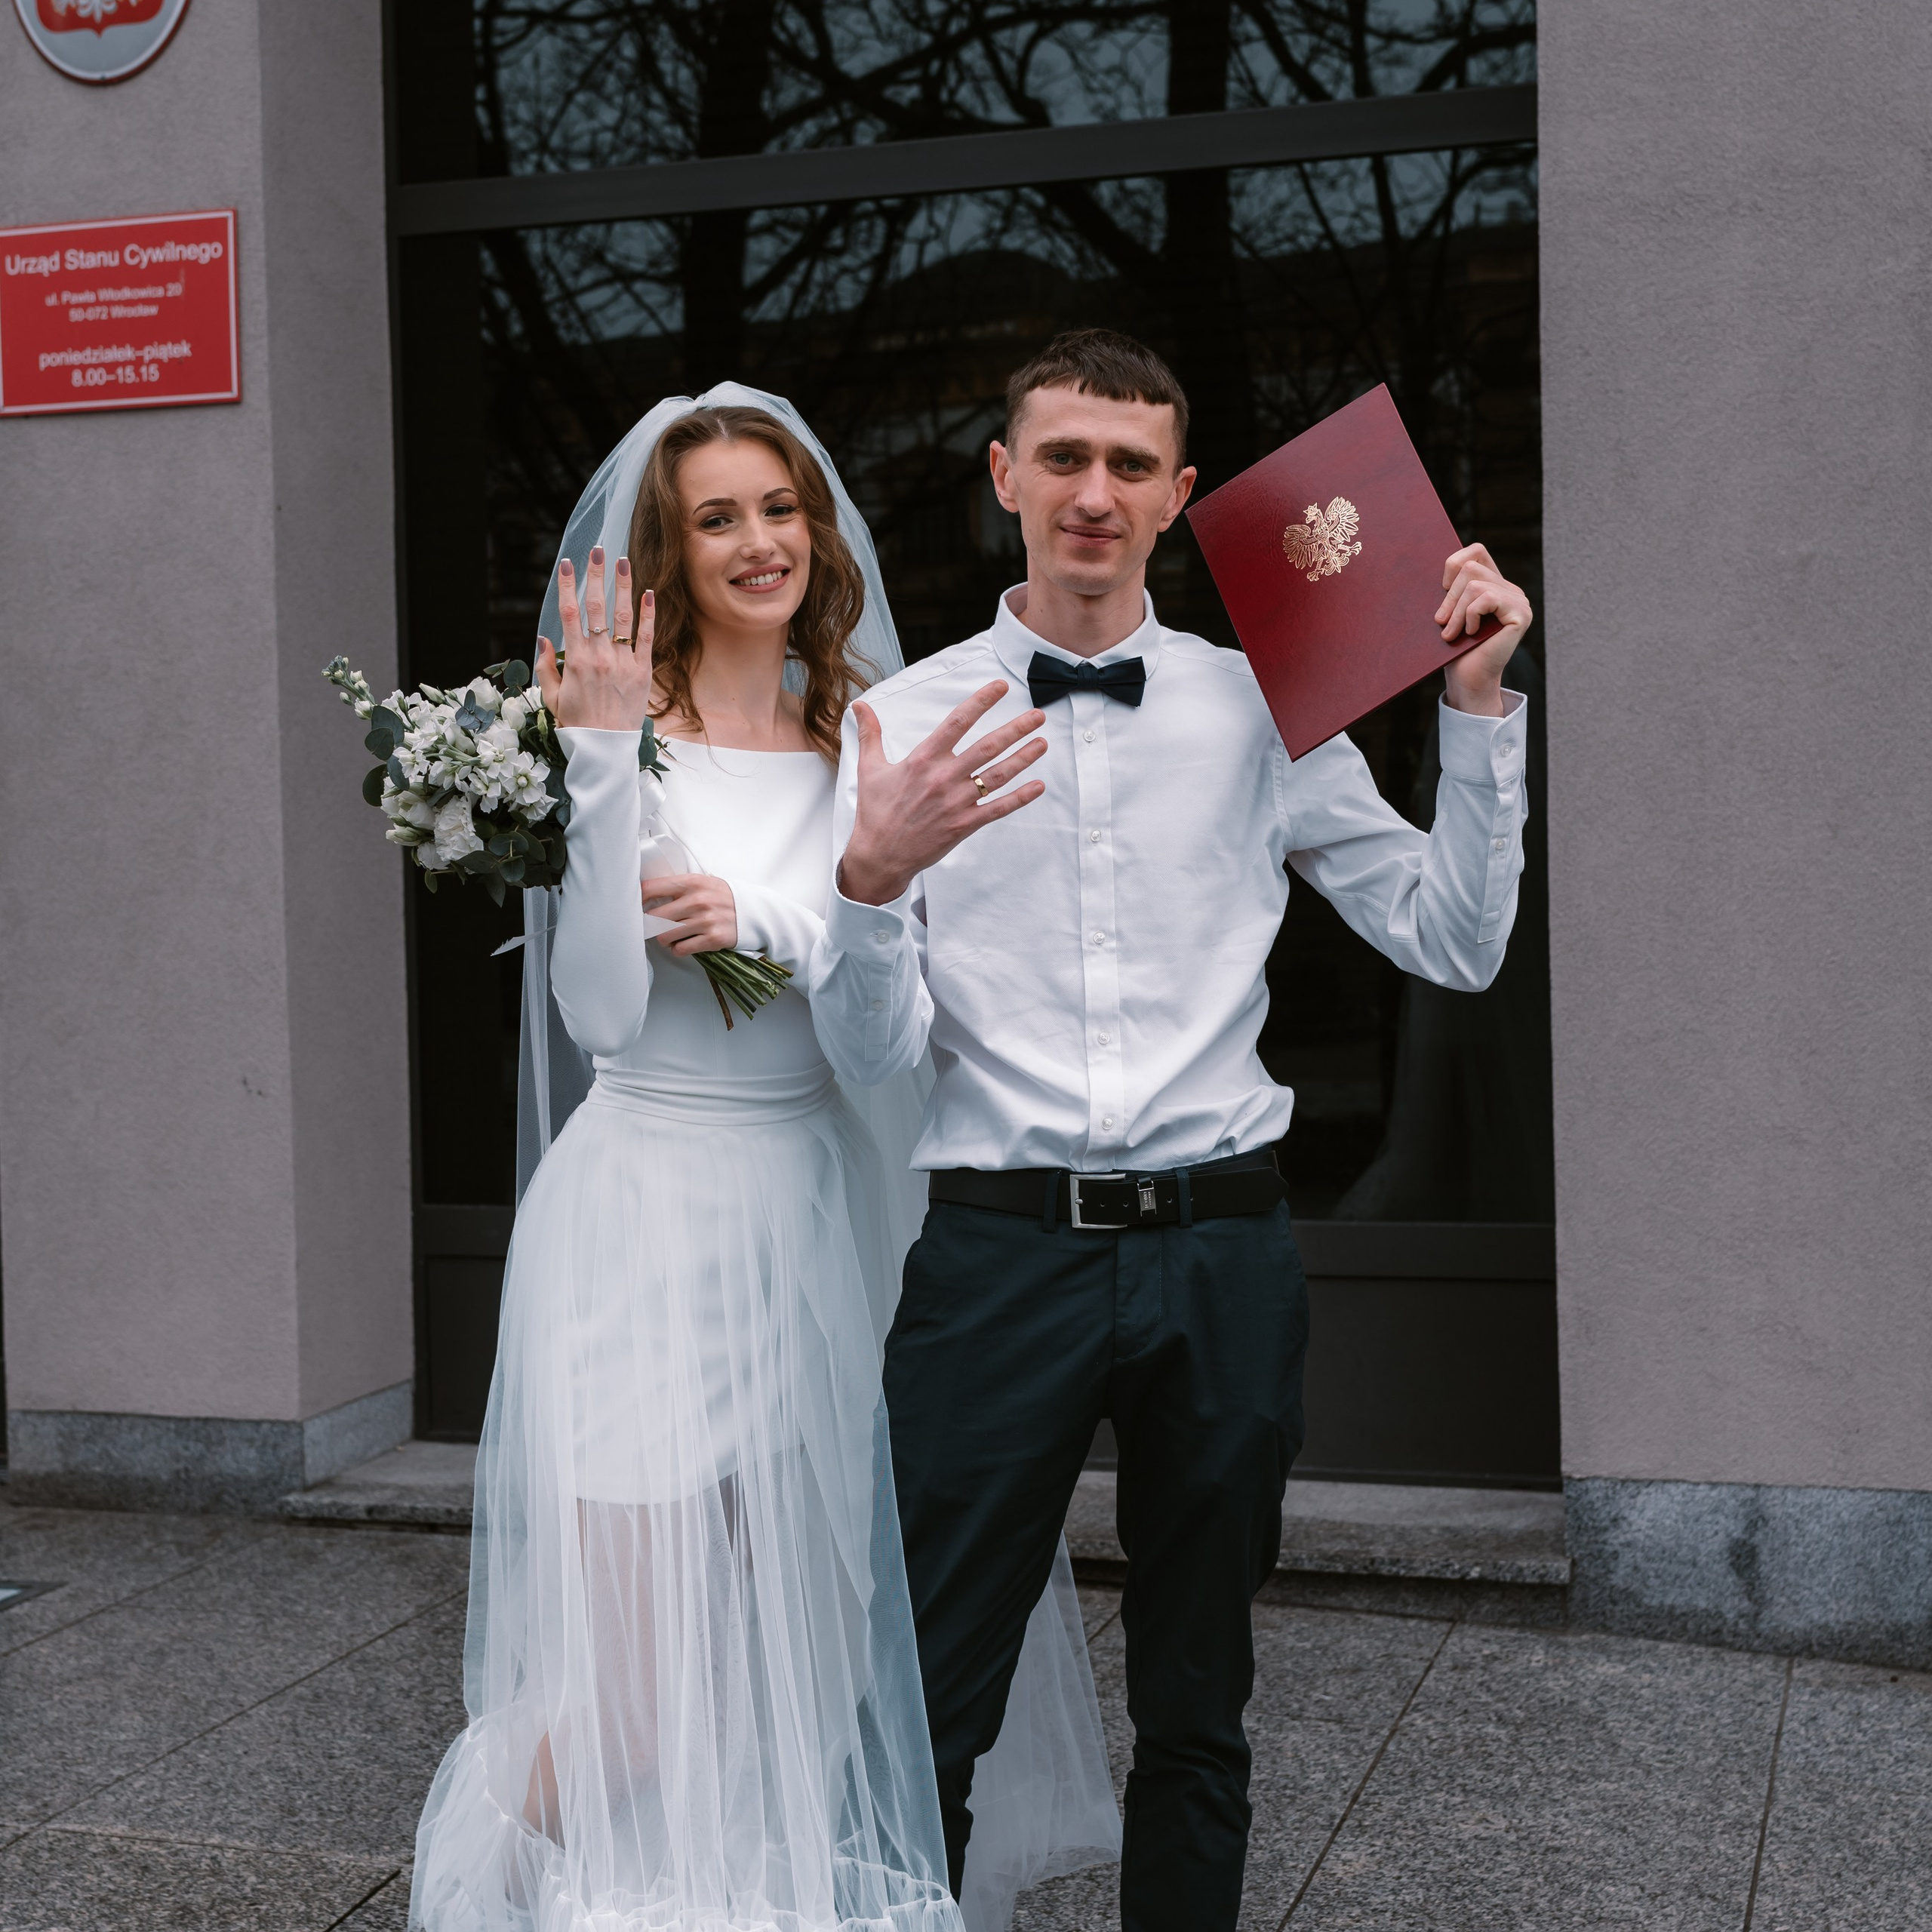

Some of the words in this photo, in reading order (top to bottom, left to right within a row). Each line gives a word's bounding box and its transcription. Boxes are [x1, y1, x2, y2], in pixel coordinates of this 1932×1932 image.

[5, 251, 60, 277] Urząd
[65, 249, 120, 271] Stanu
[124, 241, 223, 269] Cywilnego
